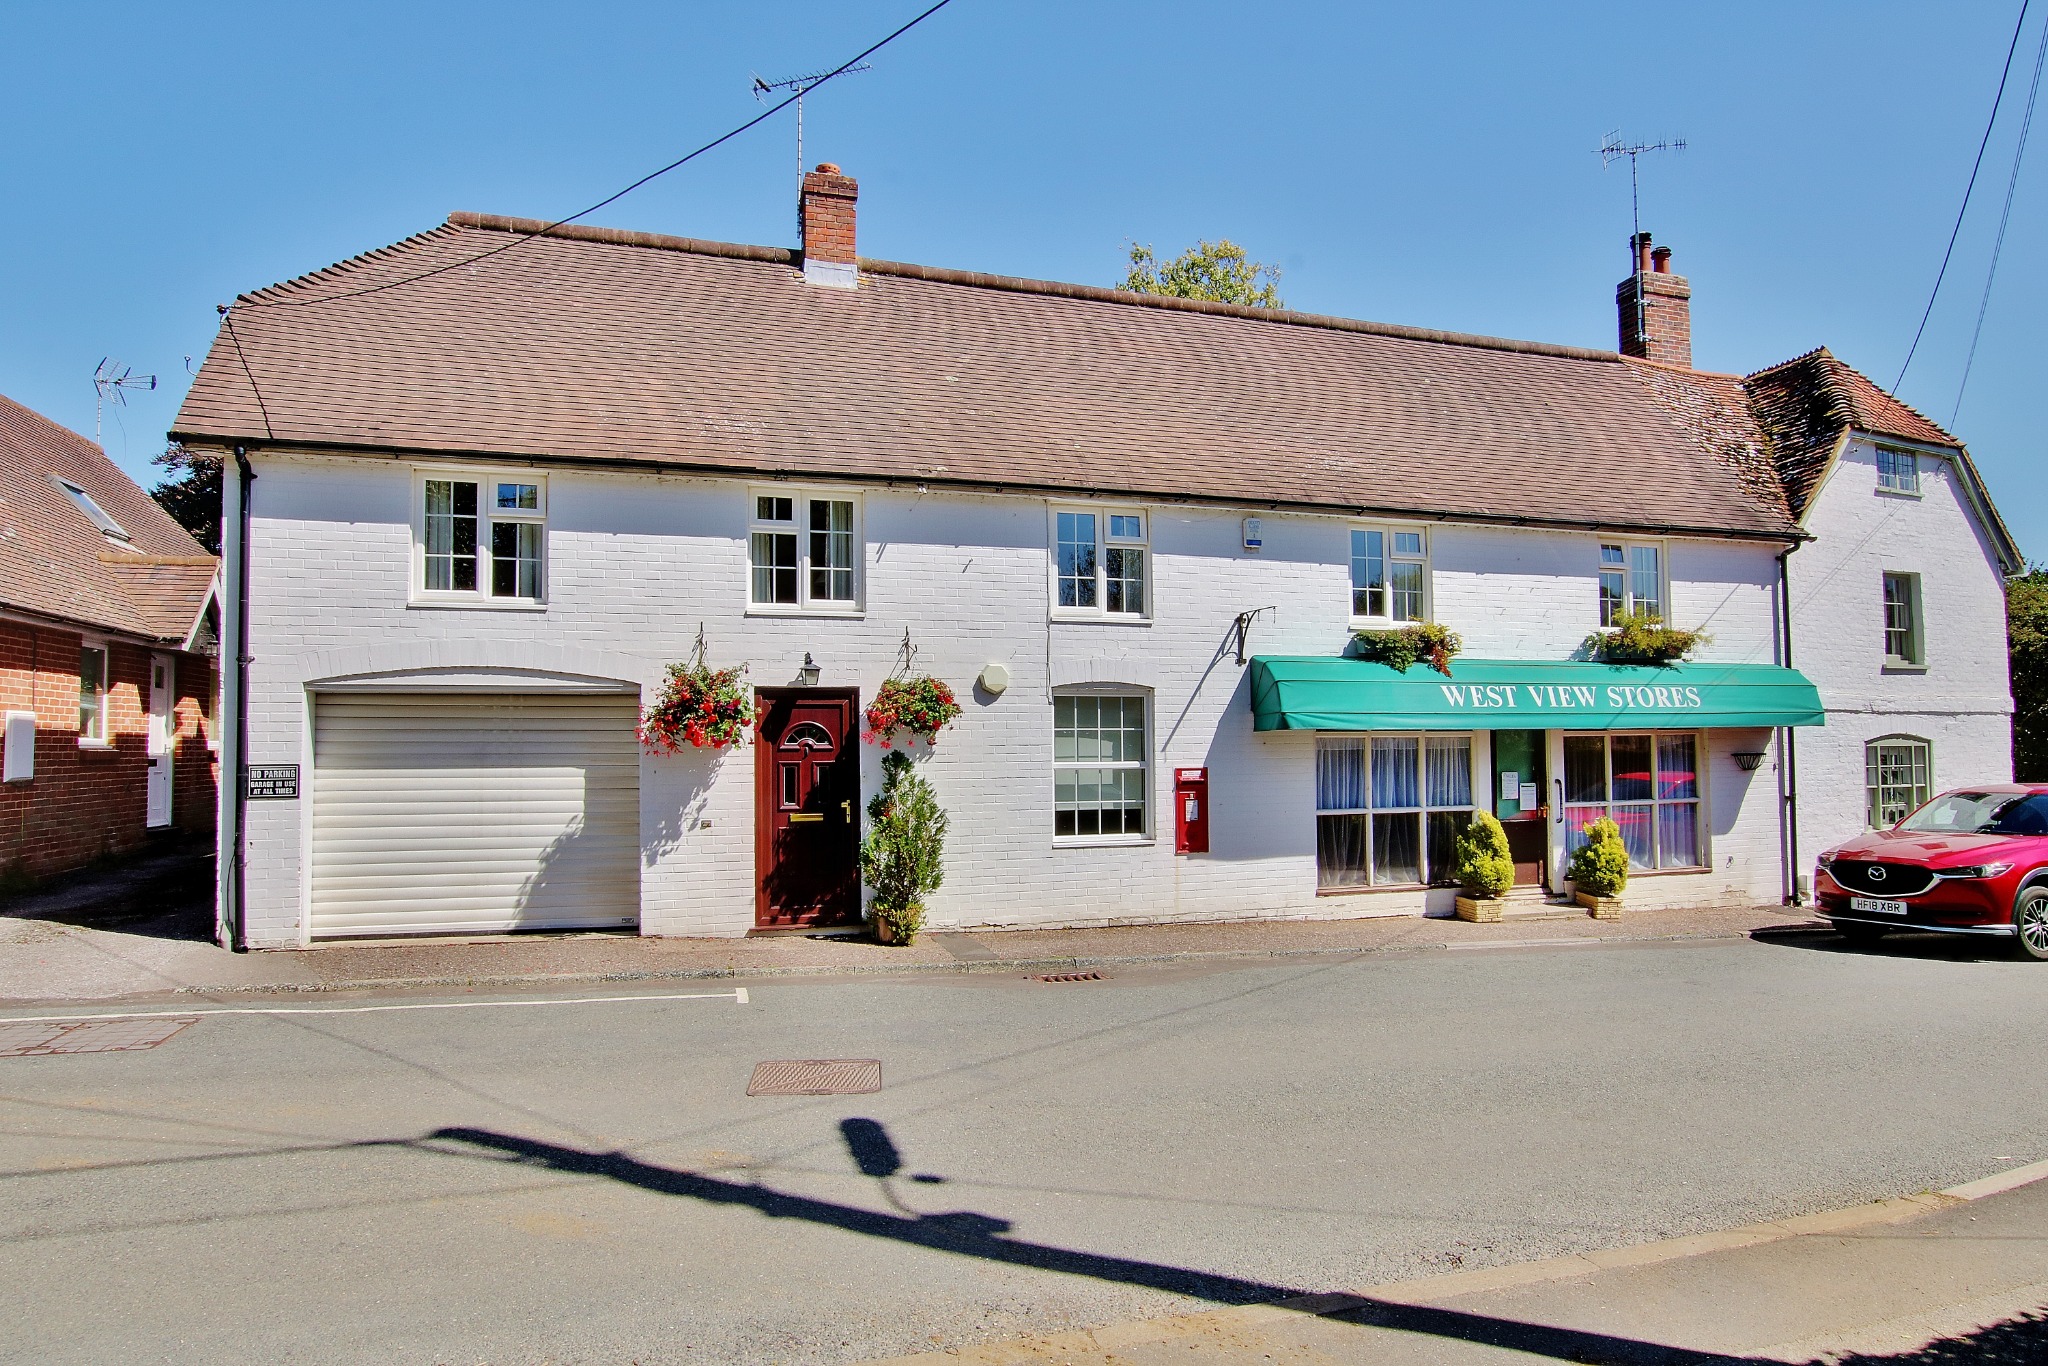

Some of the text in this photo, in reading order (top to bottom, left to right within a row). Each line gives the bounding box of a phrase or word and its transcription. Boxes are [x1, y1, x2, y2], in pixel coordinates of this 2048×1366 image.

[1440, 685, 1701, 708] WEST VIEW STORES
[251, 770, 295, 778] NO PARKING
[1857, 900, 1900, 912] HF18 XBR
